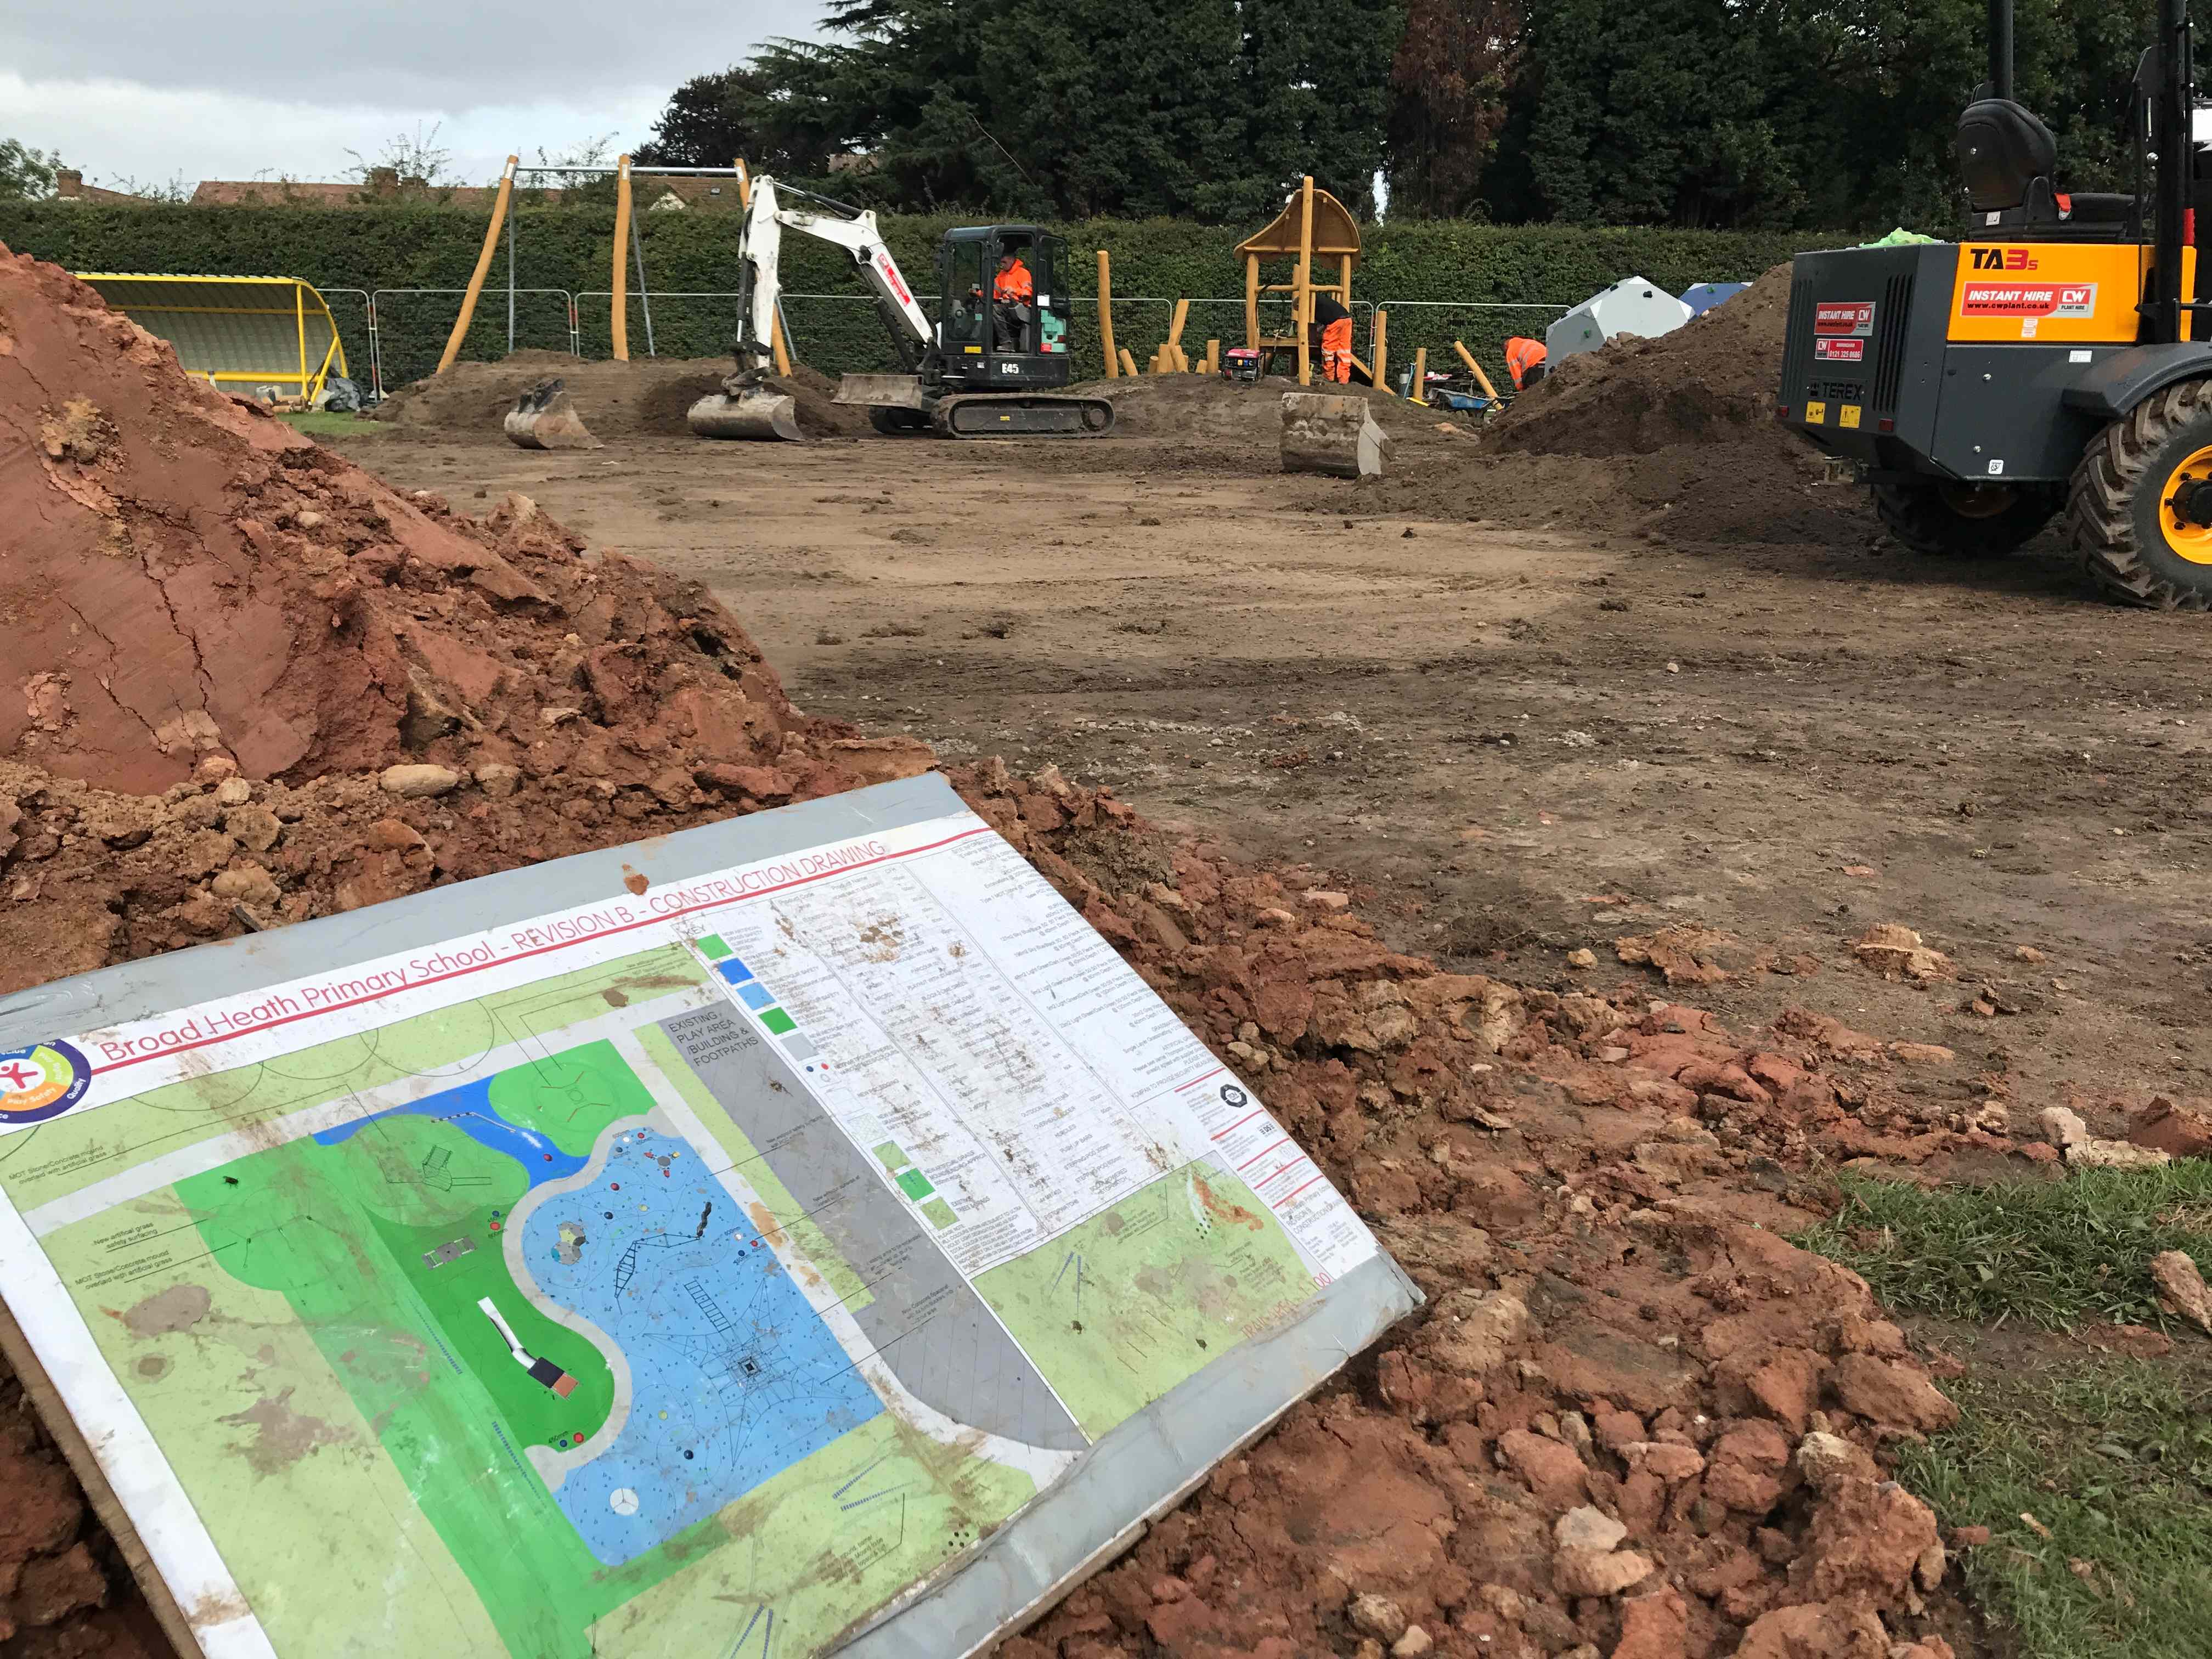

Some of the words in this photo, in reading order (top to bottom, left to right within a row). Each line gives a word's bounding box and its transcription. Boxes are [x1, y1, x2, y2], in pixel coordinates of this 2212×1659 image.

[1968, 290, 2021, 301] INSTANT
[2023, 291, 2053, 301] HIRE
[2062, 290, 2086, 302] CW
[1818, 311, 1841, 319] INSTANT
[1841, 311, 1855, 320] HIRE
[1858, 310, 1870, 321] CW
[1818, 341, 1827, 351] CW
[1002, 363, 1019, 374] E45
[1822, 382, 1861, 400] TEREX
[683, 924, 708, 936] KEY
[100, 1019, 201, 1060] Broad
[202, 993, 298, 1034] Heath
[302, 966, 408, 1008] Primary
[411, 941, 495, 977] School
[512, 911, 615, 950] REVISION
[616, 904, 636, 924] B
[650, 864, 800, 913] CONSTRUCTION
[800, 841, 885, 873] DRAWING
[676, 1027, 704, 1043] PLAY
[708, 1019, 736, 1033] AREA
[741, 1026, 749, 1035] &
[693, 1036, 759, 1066] FOOTPATHS
[66, 1078, 86, 1099] Quality
[1128, 1085, 1152, 1098] KOMPAN
[7, 1170, 25, 1180] MOT
[26, 1152, 80, 1173] Stone/Concrete
[79, 1145, 104, 1156] mound
[18, 1172, 46, 1184] overlaid
[46, 1166, 61, 1175] with
[87, 1151, 108, 1162] grass
[1293, 1207, 1327, 1234] CONSTRUCTION
[93, 1236, 109, 1245] New
[134, 1222, 154, 1233] grass
[106, 1238, 127, 1250] safety
[127, 1227, 158, 1243] surfacing
[84, 1276, 112, 1290] overlaid
[113, 1272, 126, 1280] with
[154, 1256, 173, 1268] grass
